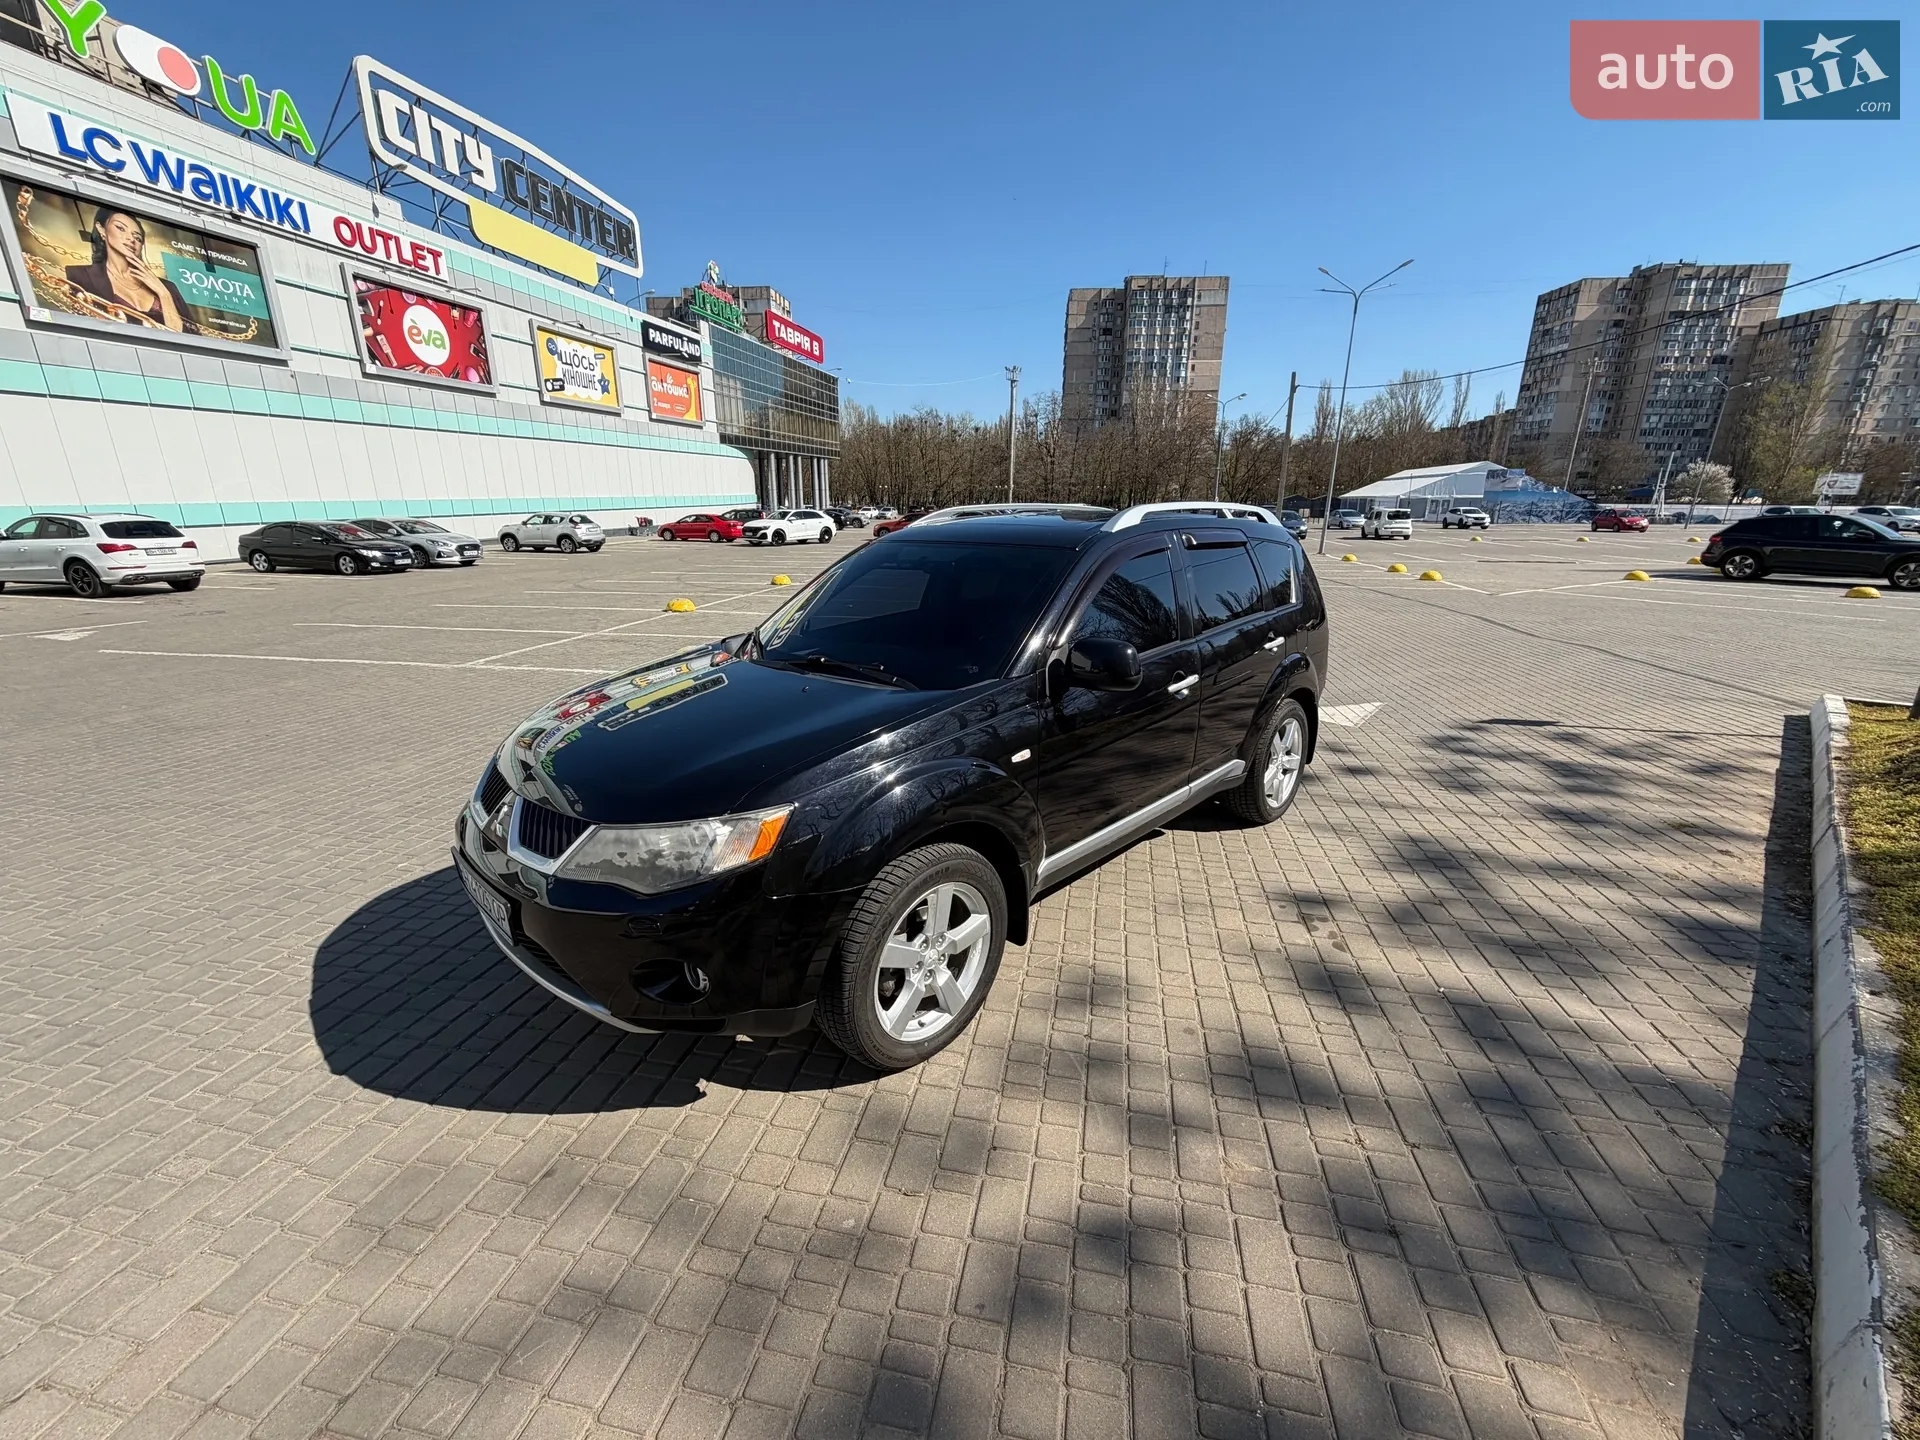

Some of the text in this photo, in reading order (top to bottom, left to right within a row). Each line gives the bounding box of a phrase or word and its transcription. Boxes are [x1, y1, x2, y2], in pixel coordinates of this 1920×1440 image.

[375, 88, 638, 262] CITY CENTER
[47, 111, 127, 173] LC
[333, 215, 443, 276] OUTLET
[171, 240, 249, 266] САМЕ ТА ПРИКРАСА
[178, 268, 256, 300] ЗОЛОТА
[772, 319, 811, 352] ТАВРІЯ
